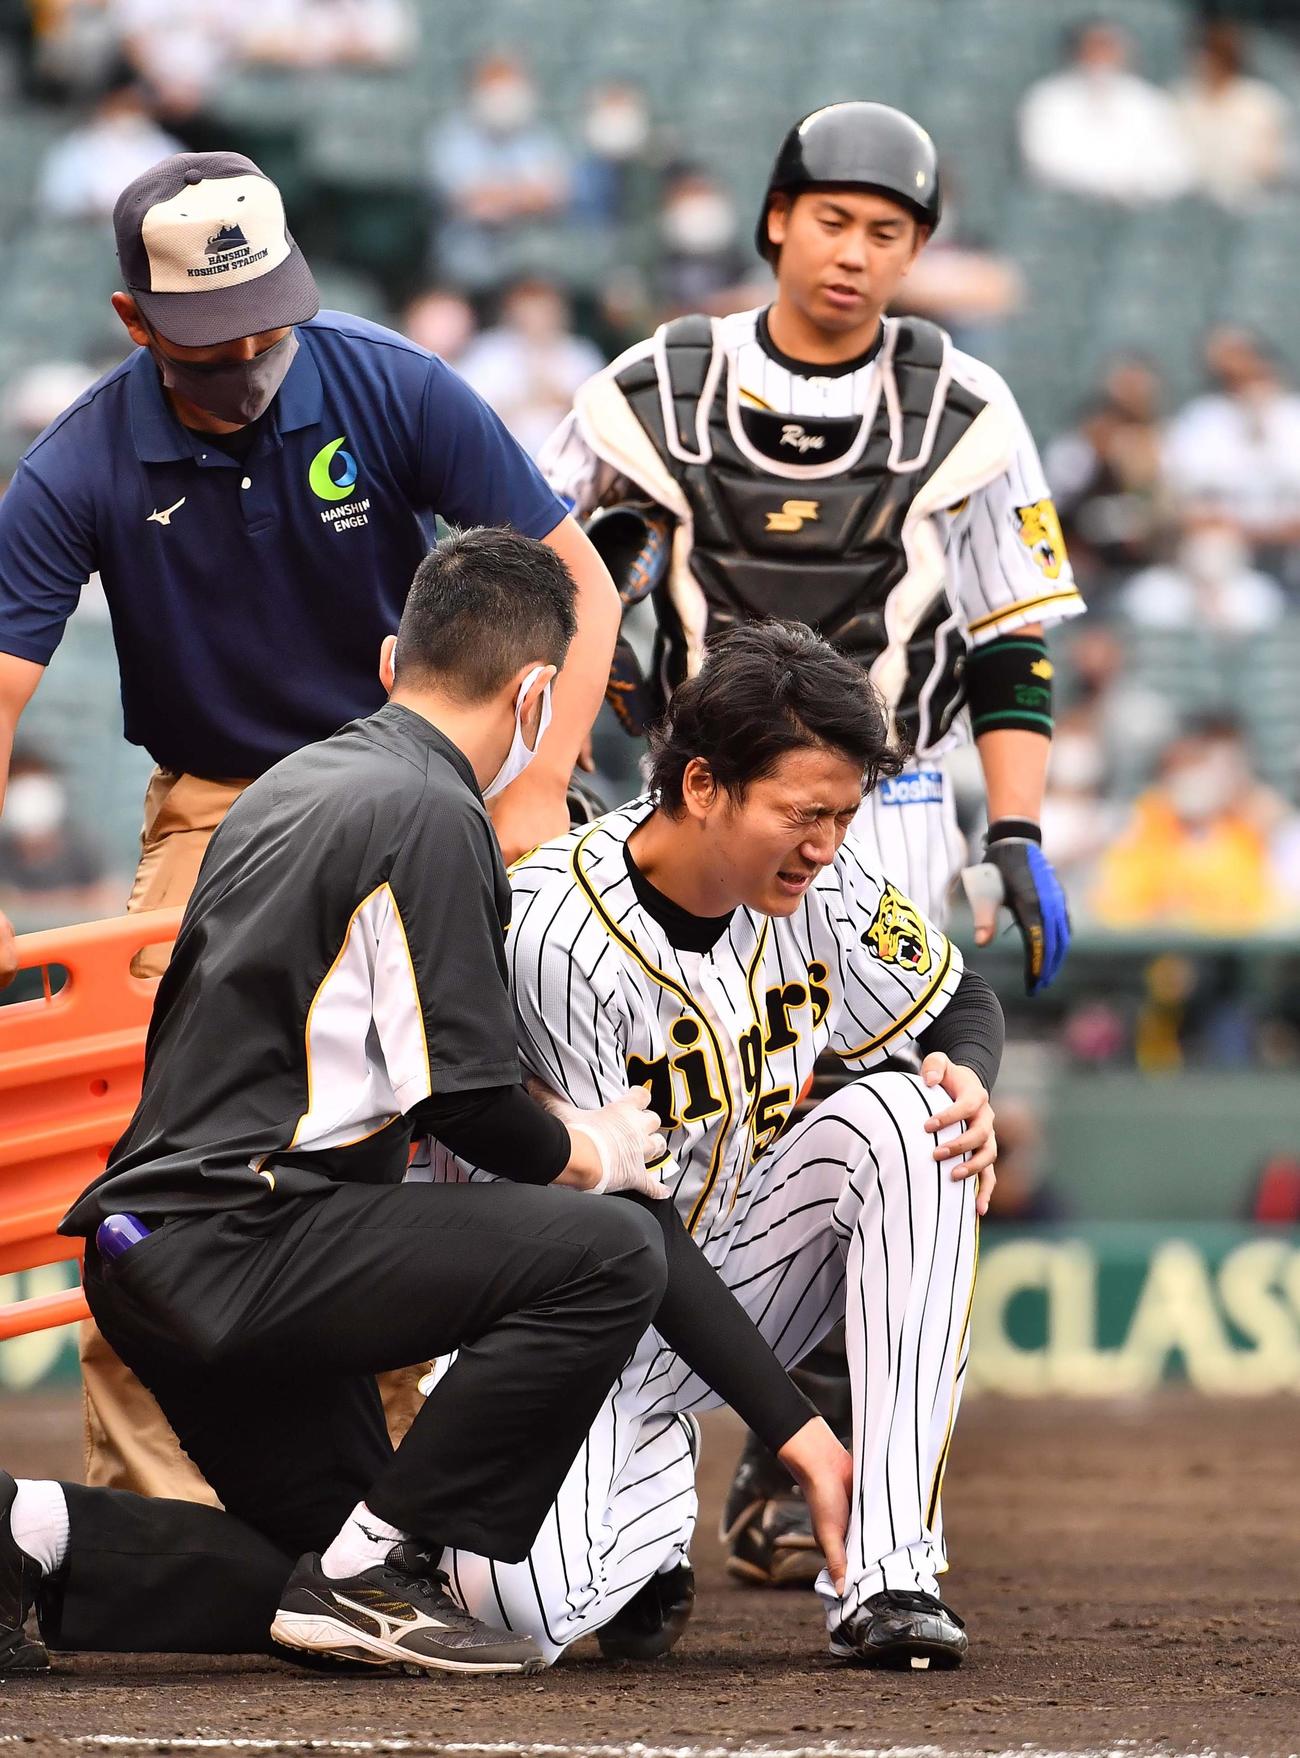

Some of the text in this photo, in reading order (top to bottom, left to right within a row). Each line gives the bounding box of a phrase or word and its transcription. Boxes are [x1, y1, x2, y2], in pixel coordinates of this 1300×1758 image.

[186, 247, 269, 277] KOSHIEN STADIUM
[208, 247, 250, 266] HANSHIN
[320, 498, 371, 523] HANSHIN
[333, 514, 369, 533] ENGEI
[970, 1236, 1300, 1394] CLAS
